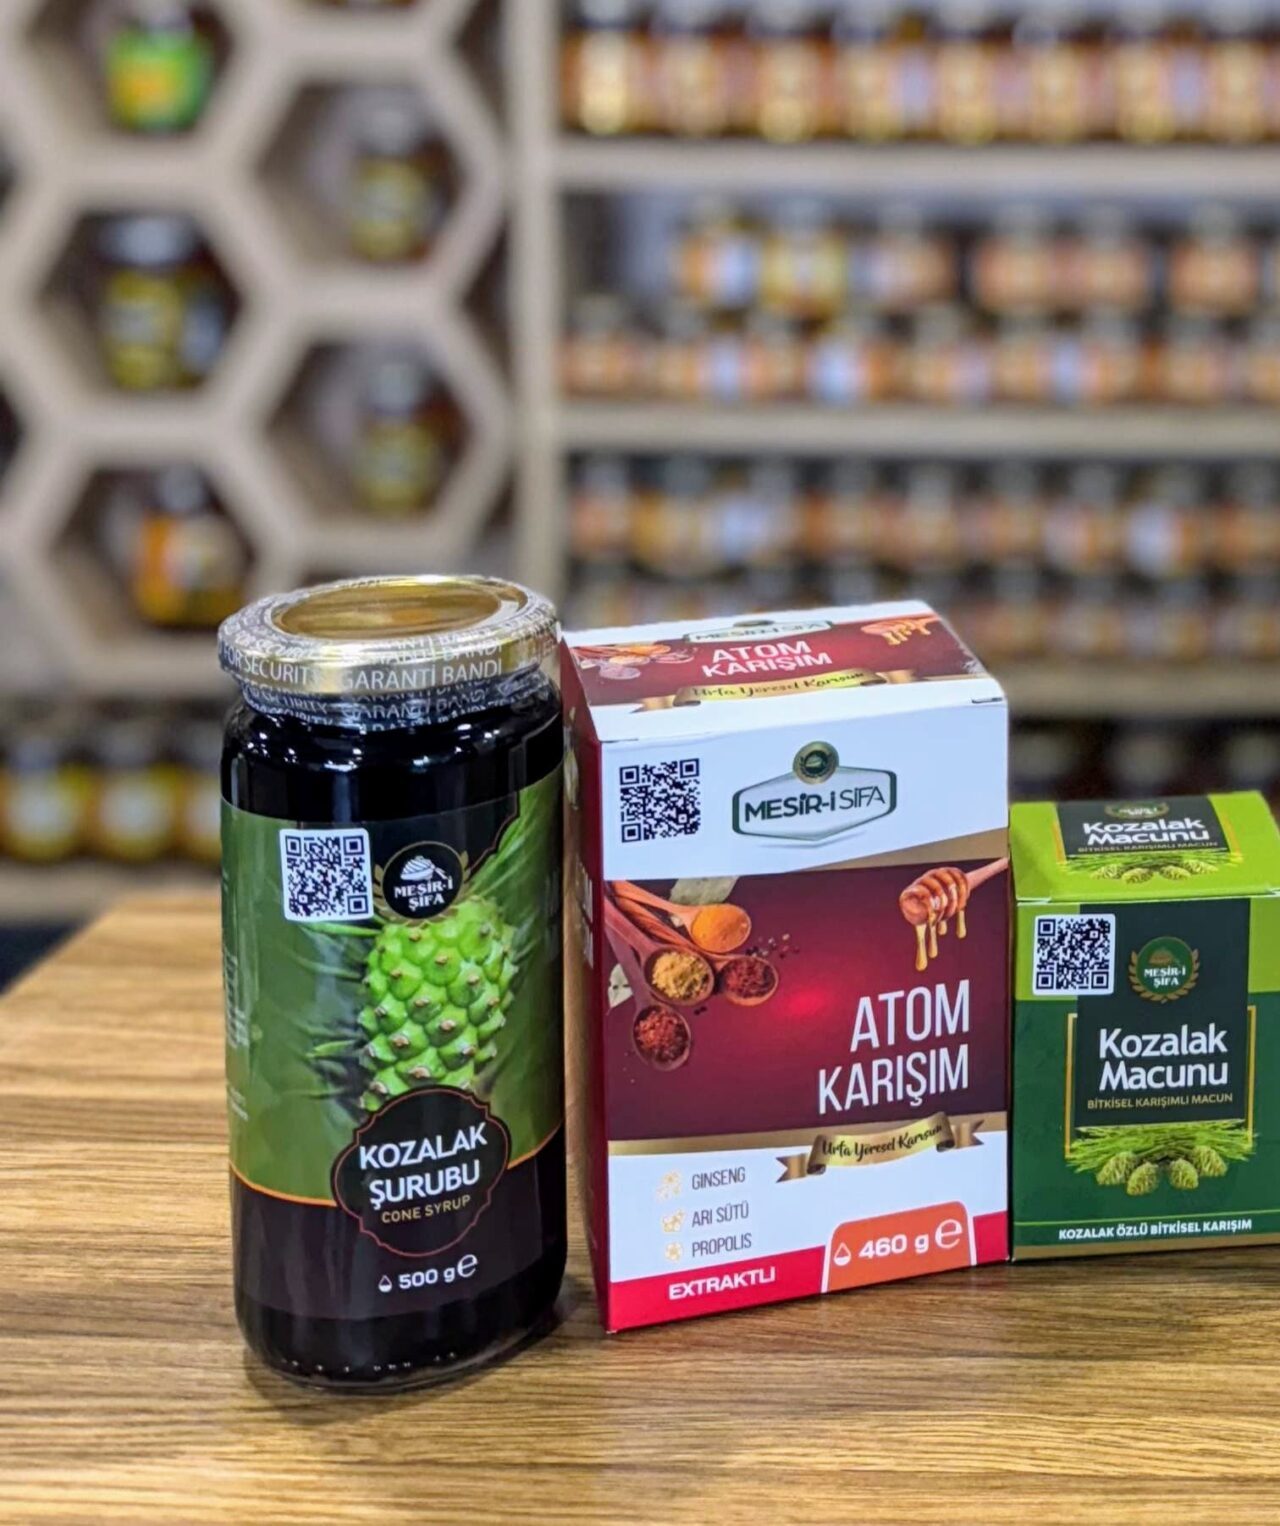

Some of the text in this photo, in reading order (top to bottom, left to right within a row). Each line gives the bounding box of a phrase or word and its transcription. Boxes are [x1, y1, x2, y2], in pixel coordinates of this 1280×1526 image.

[702, 652, 832, 678] KARIŞIM
[712, 640, 812, 664] ATOM
[1083, 817, 1205, 834] Kozalak
[1087, 830, 1210, 845] Macunu
[850, 979, 970, 1053] ATOM
[1100, 1023, 1227, 1058] Kozalak
[818, 1043, 969, 1115] KARIŞIM
[1099, 1061, 1228, 1091] Macunu
[1087, 1093, 1233, 1110] BİTKİSEL KARIŞIMLI MACUN
[359, 1122, 488, 1170] KOZALAK
[369, 1159, 480, 1211] ŞURUBU
[381, 1194, 471, 1223] CONE SYRUP
[691, 1200, 750, 1228] ARI SÜTÜ
[1058, 1219, 1252, 1241] KOZALAK ÖZLÜ BİTKİSEL KARIŞIM
[691, 1232, 753, 1257] PROPOLIS
[859, 1235, 906, 1259] 460
[398, 1268, 438, 1289] 500
[668, 1266, 776, 1301] EXTRAKTLI
